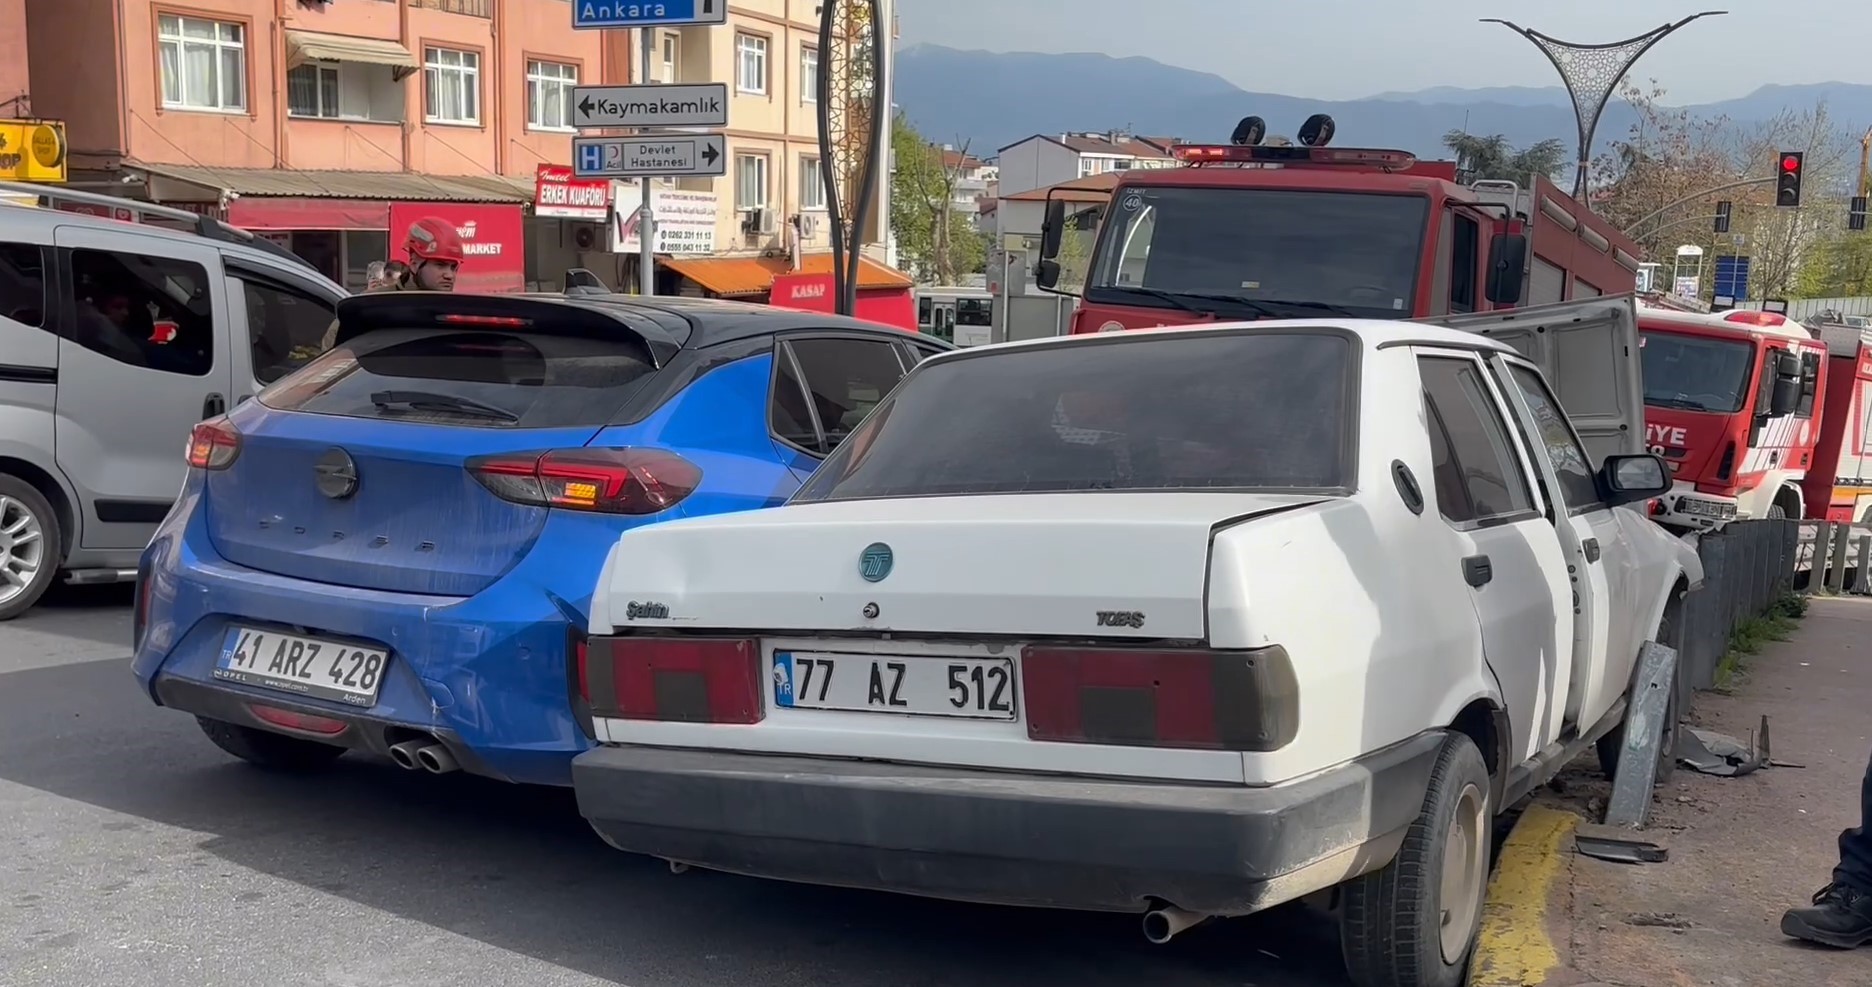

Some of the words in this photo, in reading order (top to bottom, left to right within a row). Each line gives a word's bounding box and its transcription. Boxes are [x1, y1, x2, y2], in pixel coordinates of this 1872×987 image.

[582, 1, 665, 19] Ankara
[598, 97, 719, 118] Kaymakamlık
[639, 145, 675, 154] Devlet
[0, 152, 21, 170] OP
[581, 146, 600, 169] H
[631, 157, 687, 167] Hastanesi
[541, 183, 568, 204] ERKEK
[568, 183, 606, 206] KUAFÖRÜ
[1125, 198, 1139, 207] 40
[462, 243, 502, 255] MARKET
[792, 284, 826, 299] KASAP
[626, 600, 670, 621] Şahin
[222, 649, 231, 659] TR
[233, 632, 264, 669] 41
[268, 638, 321, 679] ARZ
[328, 649, 382, 690] 428
[223, 671, 248, 682] OPEL
[777, 682, 792, 695] TR
[796, 658, 834, 701] 77
[868, 661, 908, 706] AZ
[948, 665, 1010, 711] 512
[343, 692, 366, 704] Arden
